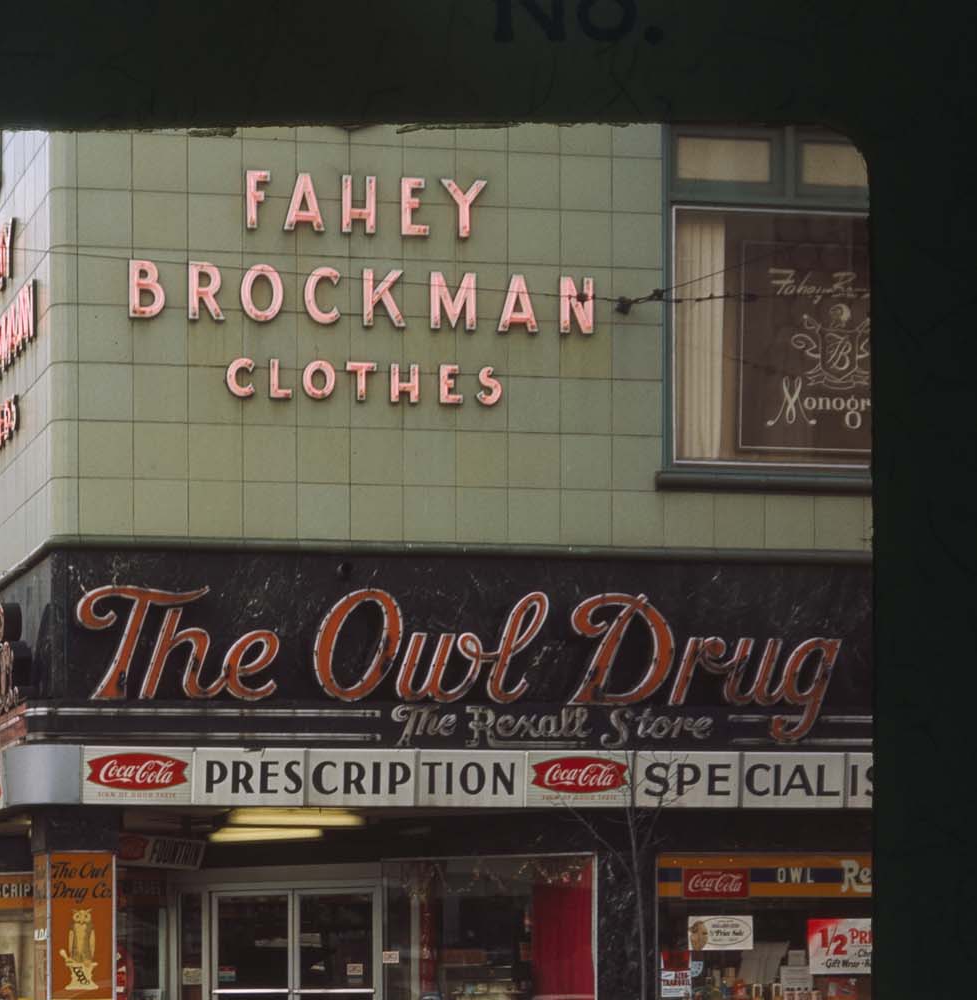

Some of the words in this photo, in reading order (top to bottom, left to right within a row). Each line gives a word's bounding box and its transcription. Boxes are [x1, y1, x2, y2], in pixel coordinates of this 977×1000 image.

[245, 170, 488, 238] FAHEY
[128, 258, 595, 335] BROCKMAN
[226, 356, 503, 406] CLOTHES
[76, 584, 280, 701] The
[313, 588, 550, 704] Owl
[566, 592, 843, 742] Drug
[390, 703, 457, 747] The
[465, 705, 593, 747] Rexall
[600, 704, 715, 750] Store
[99, 759, 176, 785] Coca-Cola
[205, 759, 516, 796] PRESCRIPTION
[543, 762, 616, 787] Coca-Cola
[50, 860, 78, 880] The
[79, 859, 112, 880] Owl
[687, 870, 743, 894] Coca-Cola
[777, 867, 815, 884] OWL
[51, 880, 89, 904] Drug
